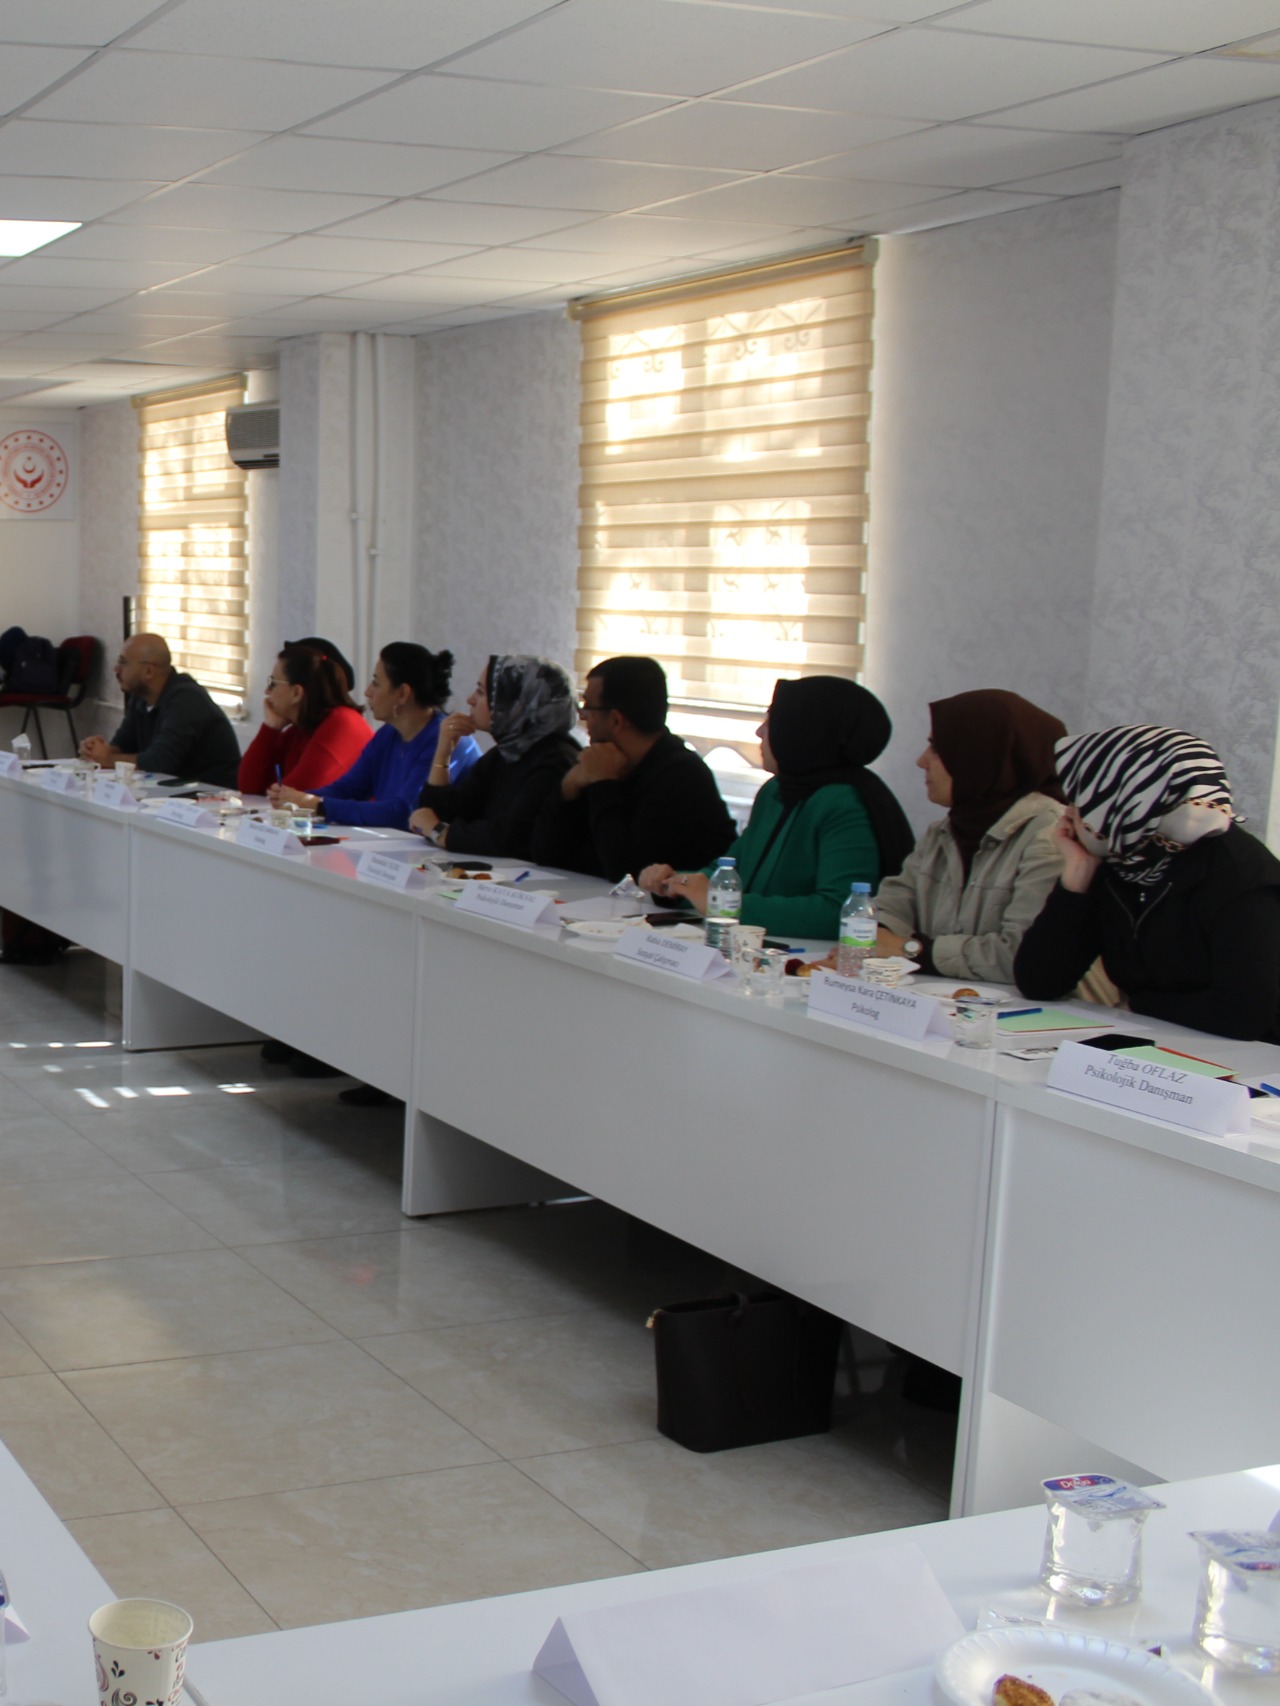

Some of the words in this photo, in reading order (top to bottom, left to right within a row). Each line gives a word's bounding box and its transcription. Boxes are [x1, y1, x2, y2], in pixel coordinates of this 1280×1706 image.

[824, 976, 857, 994] Rumeysa
[857, 984, 875, 998] Kara
[851, 1001, 880, 1021] Psikolog
[1107, 1053, 1141, 1071] Tuğba
[1141, 1063, 1188, 1085] OFLAZ
[1084, 1064, 1138, 1089] Psikolojik
[1138, 1079, 1194, 1106] Danışman
